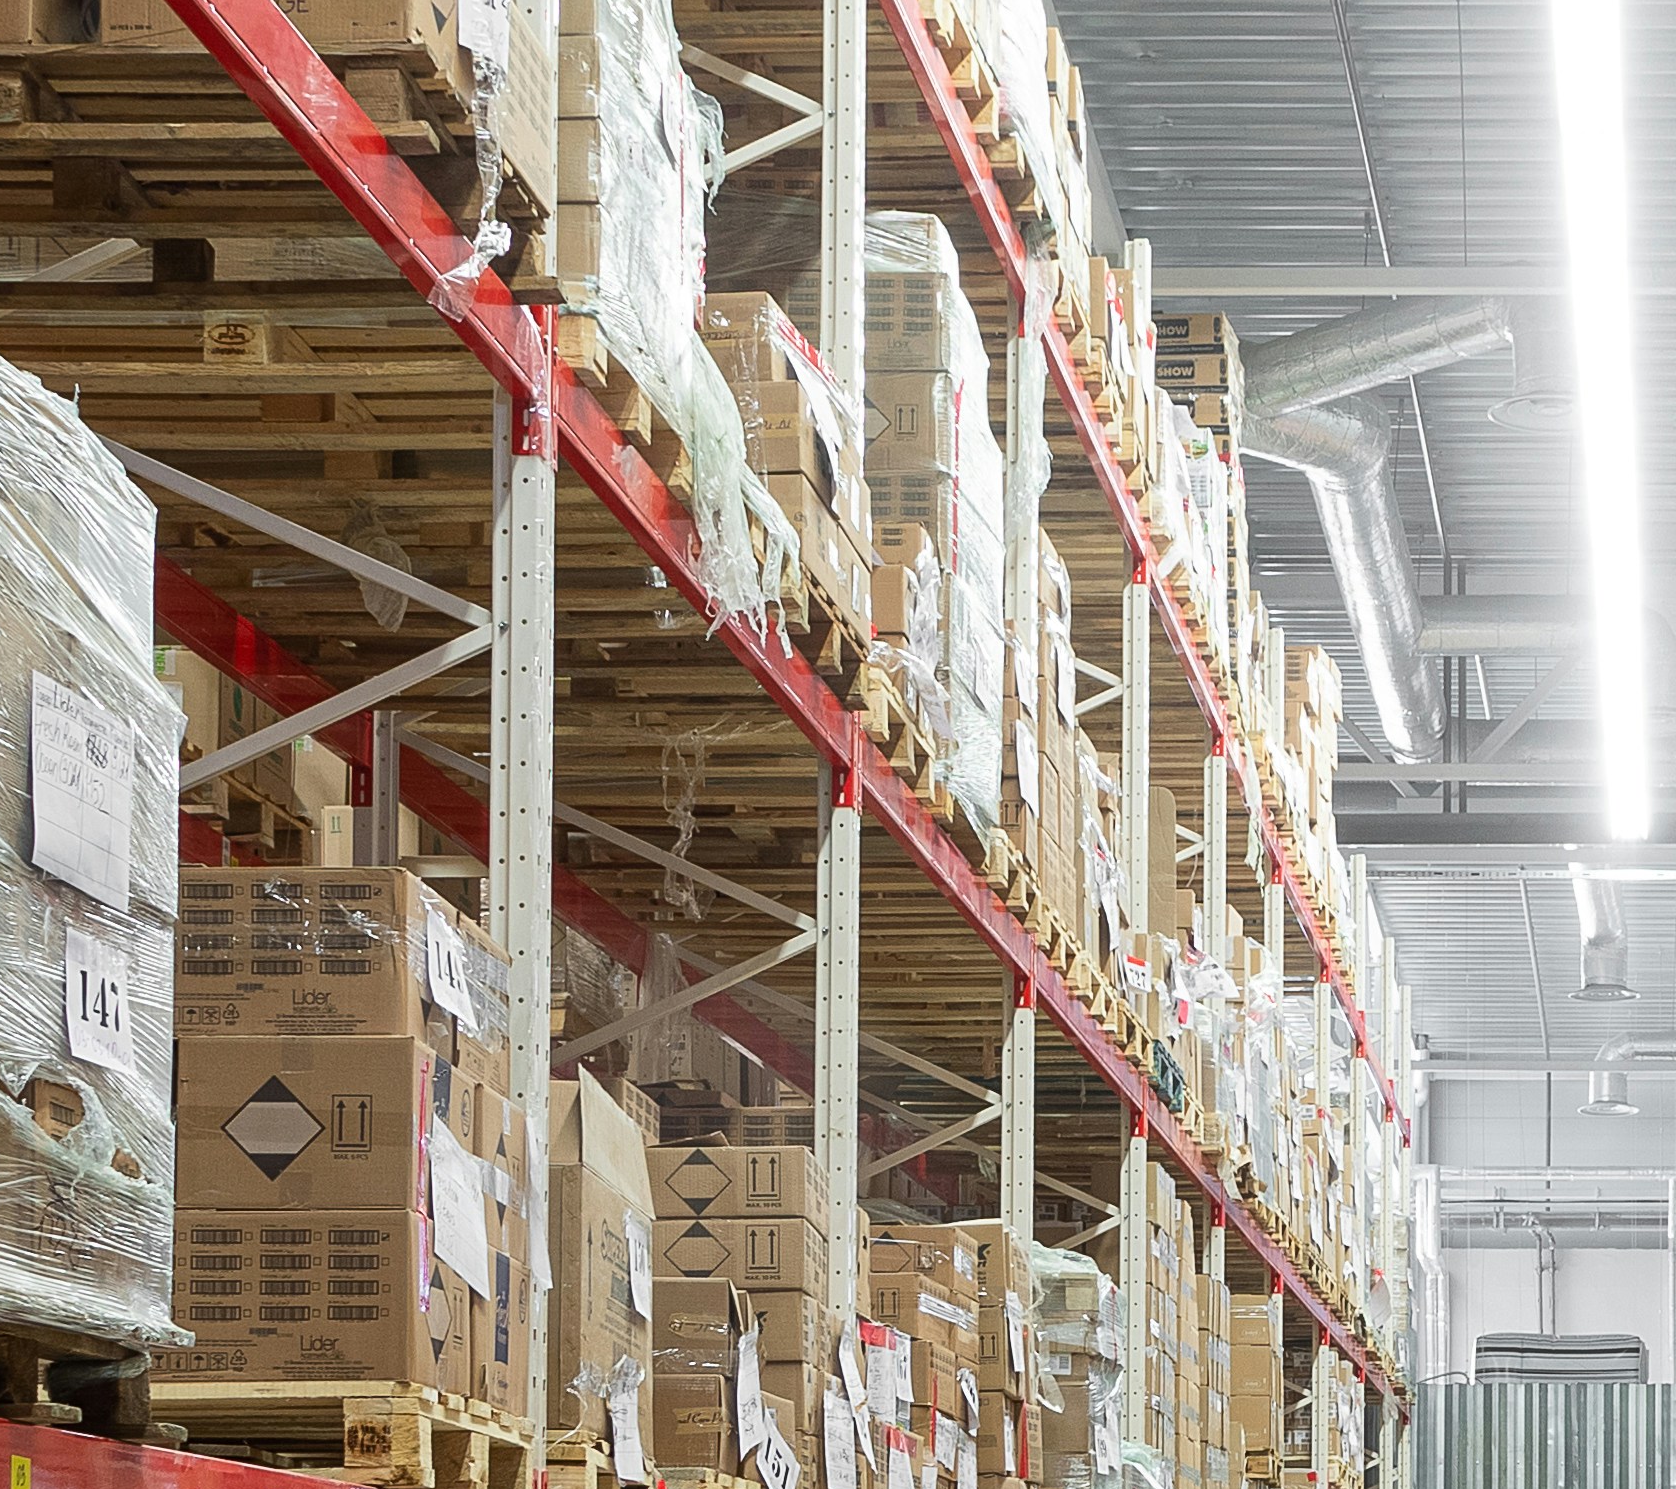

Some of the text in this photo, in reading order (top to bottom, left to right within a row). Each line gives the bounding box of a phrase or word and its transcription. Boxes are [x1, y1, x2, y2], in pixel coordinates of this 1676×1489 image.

[78, 970, 118, 1032] 147
[291, 989, 330, 1004] Lider
[299, 1335, 339, 1351] Lider
